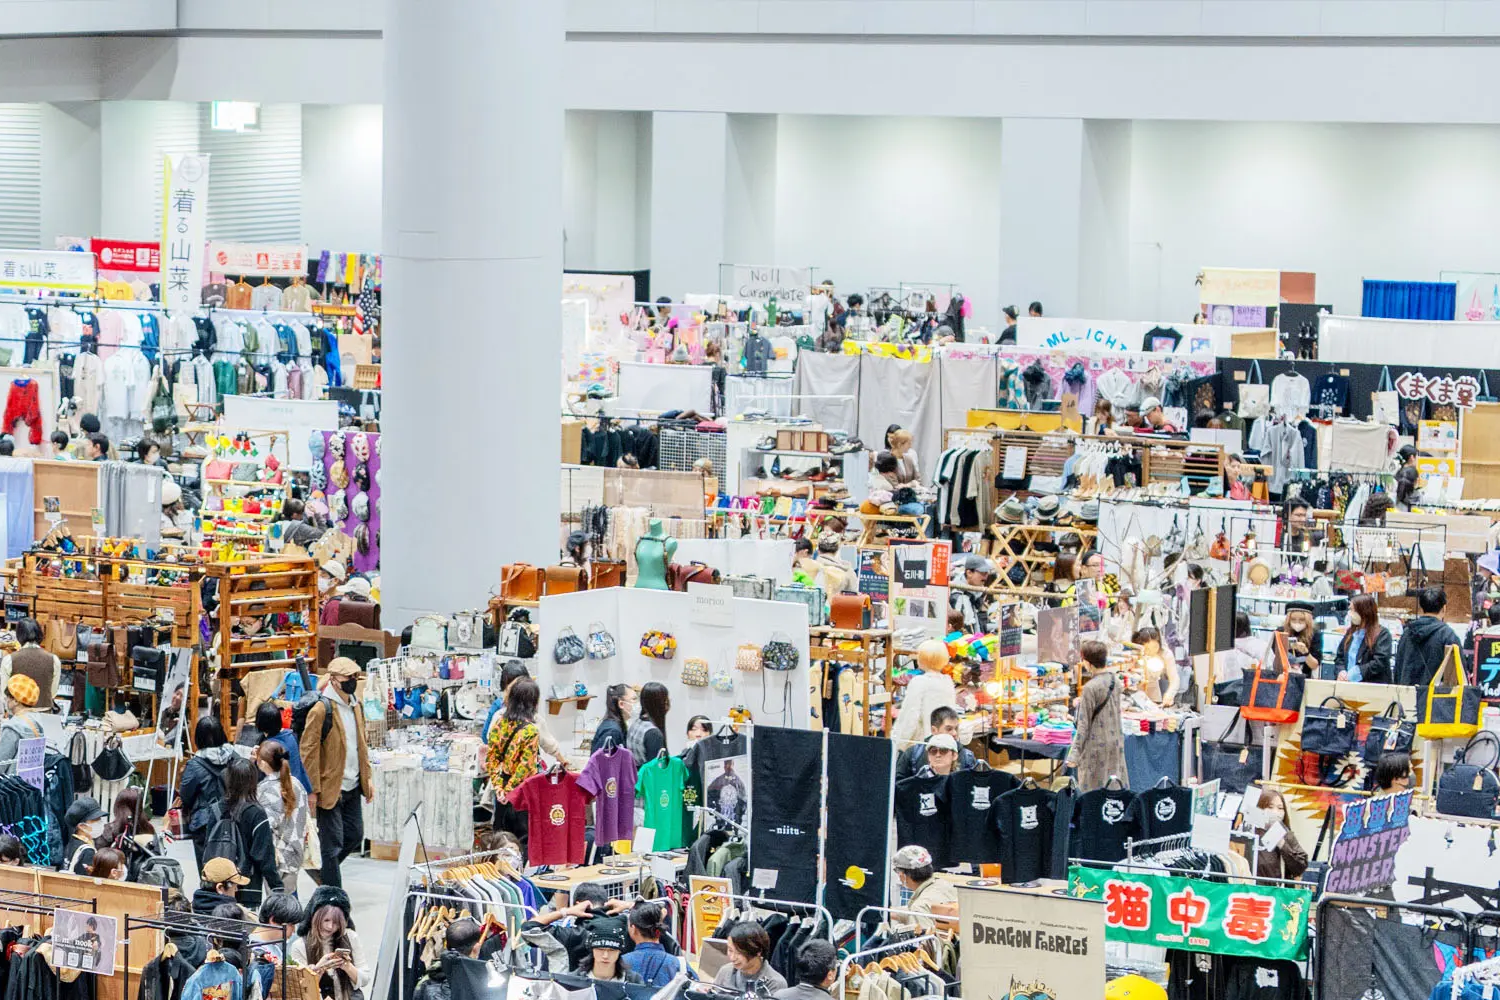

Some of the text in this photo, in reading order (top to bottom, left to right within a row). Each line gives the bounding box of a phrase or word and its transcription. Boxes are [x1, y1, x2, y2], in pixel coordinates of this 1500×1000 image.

[1396, 374, 1478, 408] くまくま堂
[1332, 826, 1410, 867] MONSTER
[1327, 857, 1396, 893] GALLER
[1105, 881, 1276, 943] 猫中毒
[972, 921, 1032, 949] DRAGON
